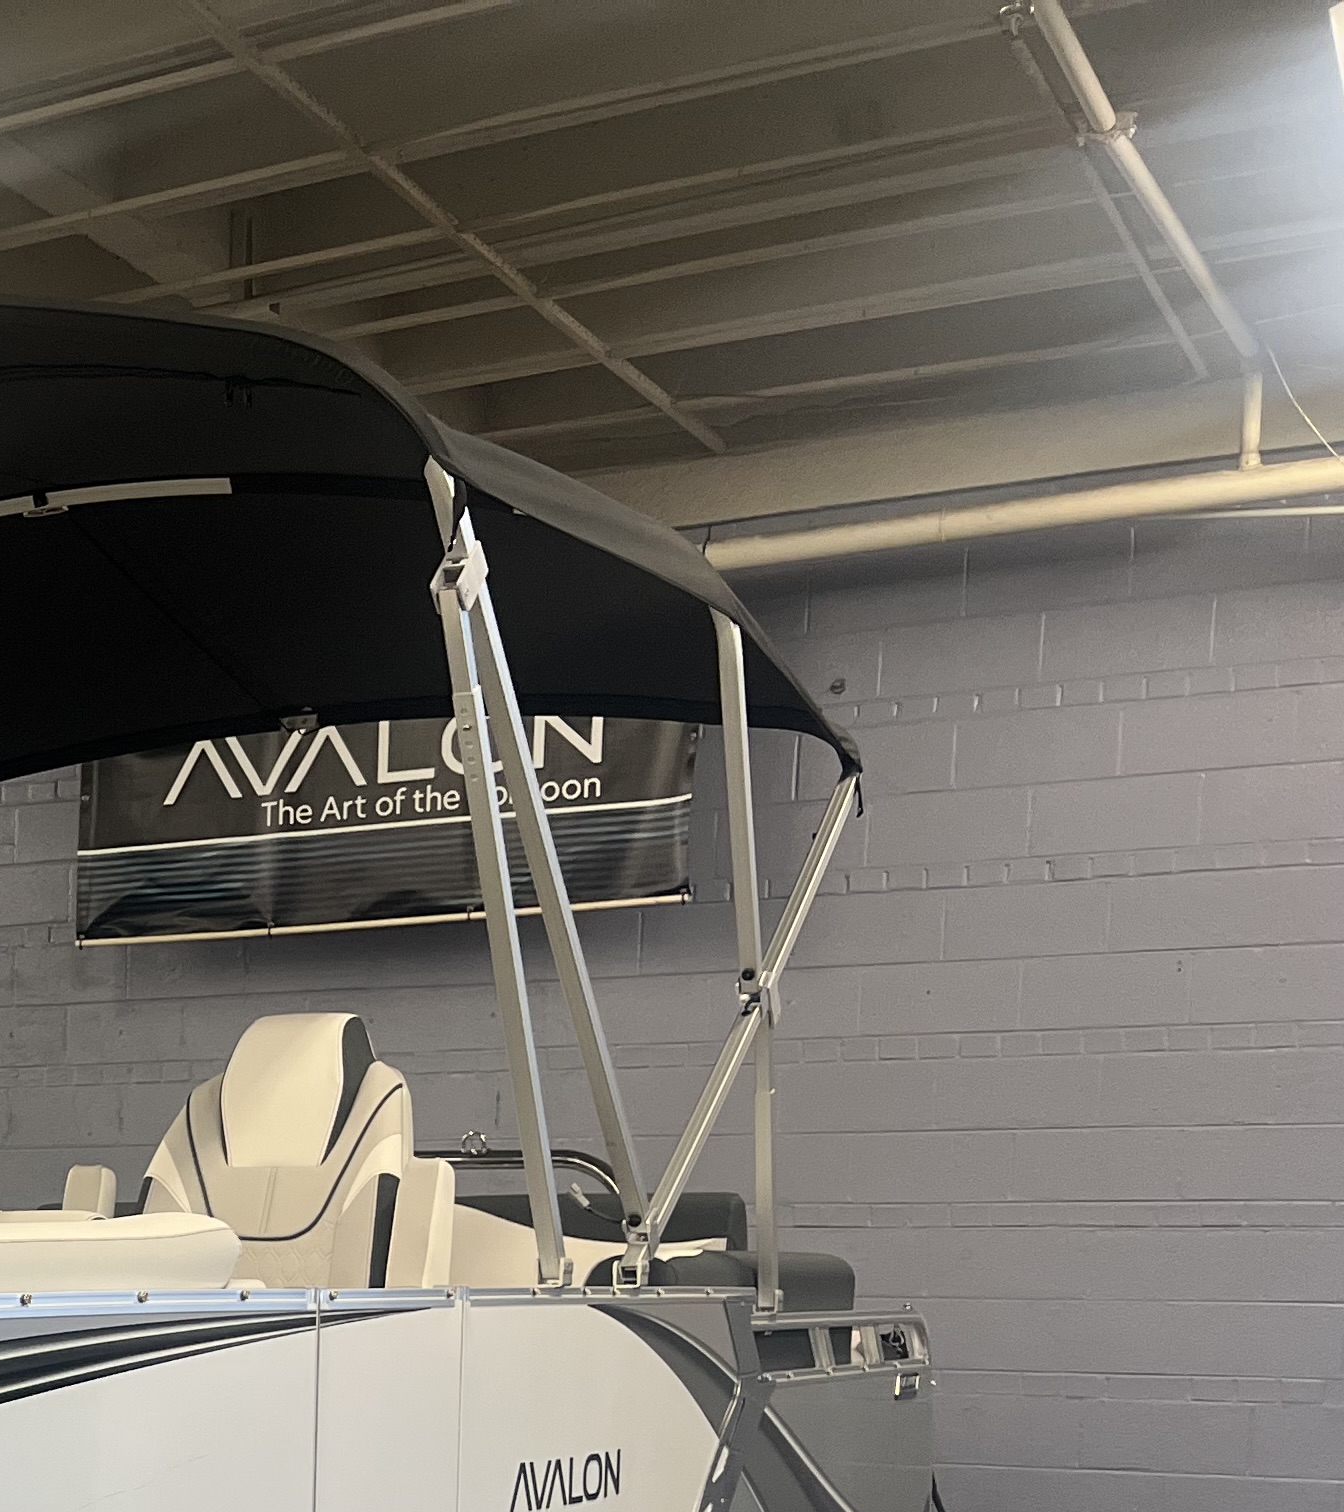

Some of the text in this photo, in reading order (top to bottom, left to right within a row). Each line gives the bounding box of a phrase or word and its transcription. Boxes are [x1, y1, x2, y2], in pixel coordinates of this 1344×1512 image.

[261, 777, 601, 826] The Art of the ooon
